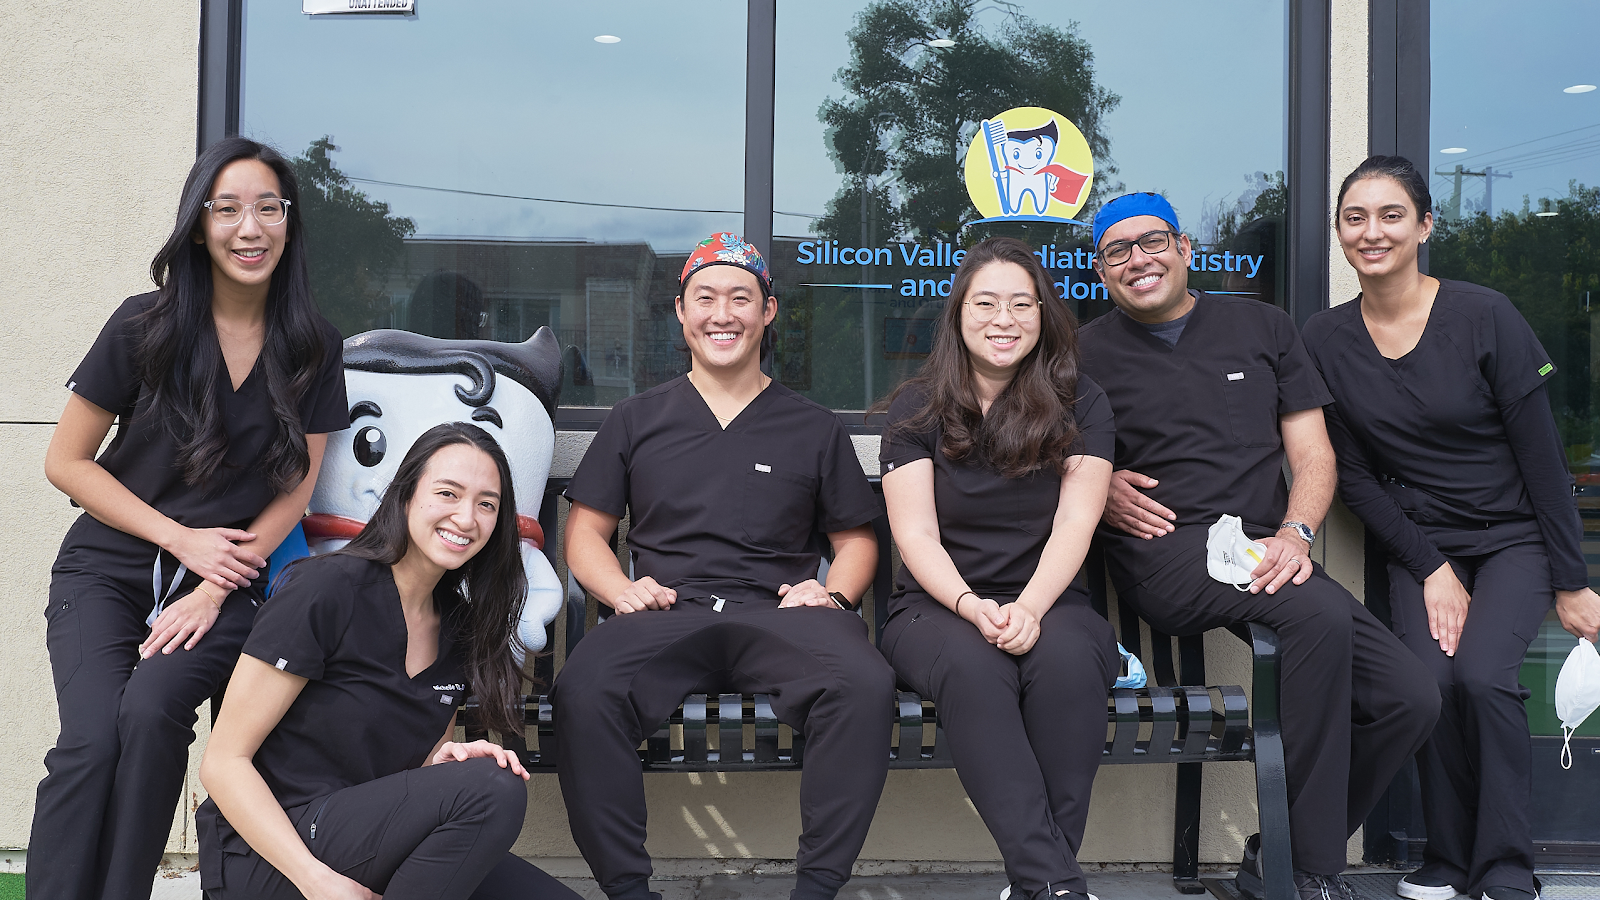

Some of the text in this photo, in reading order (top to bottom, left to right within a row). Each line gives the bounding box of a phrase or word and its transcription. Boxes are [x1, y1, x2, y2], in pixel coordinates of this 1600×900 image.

[796, 239, 893, 266] Silicon
[898, 242, 968, 267] Valle
[1191, 247, 1264, 279] tistry
